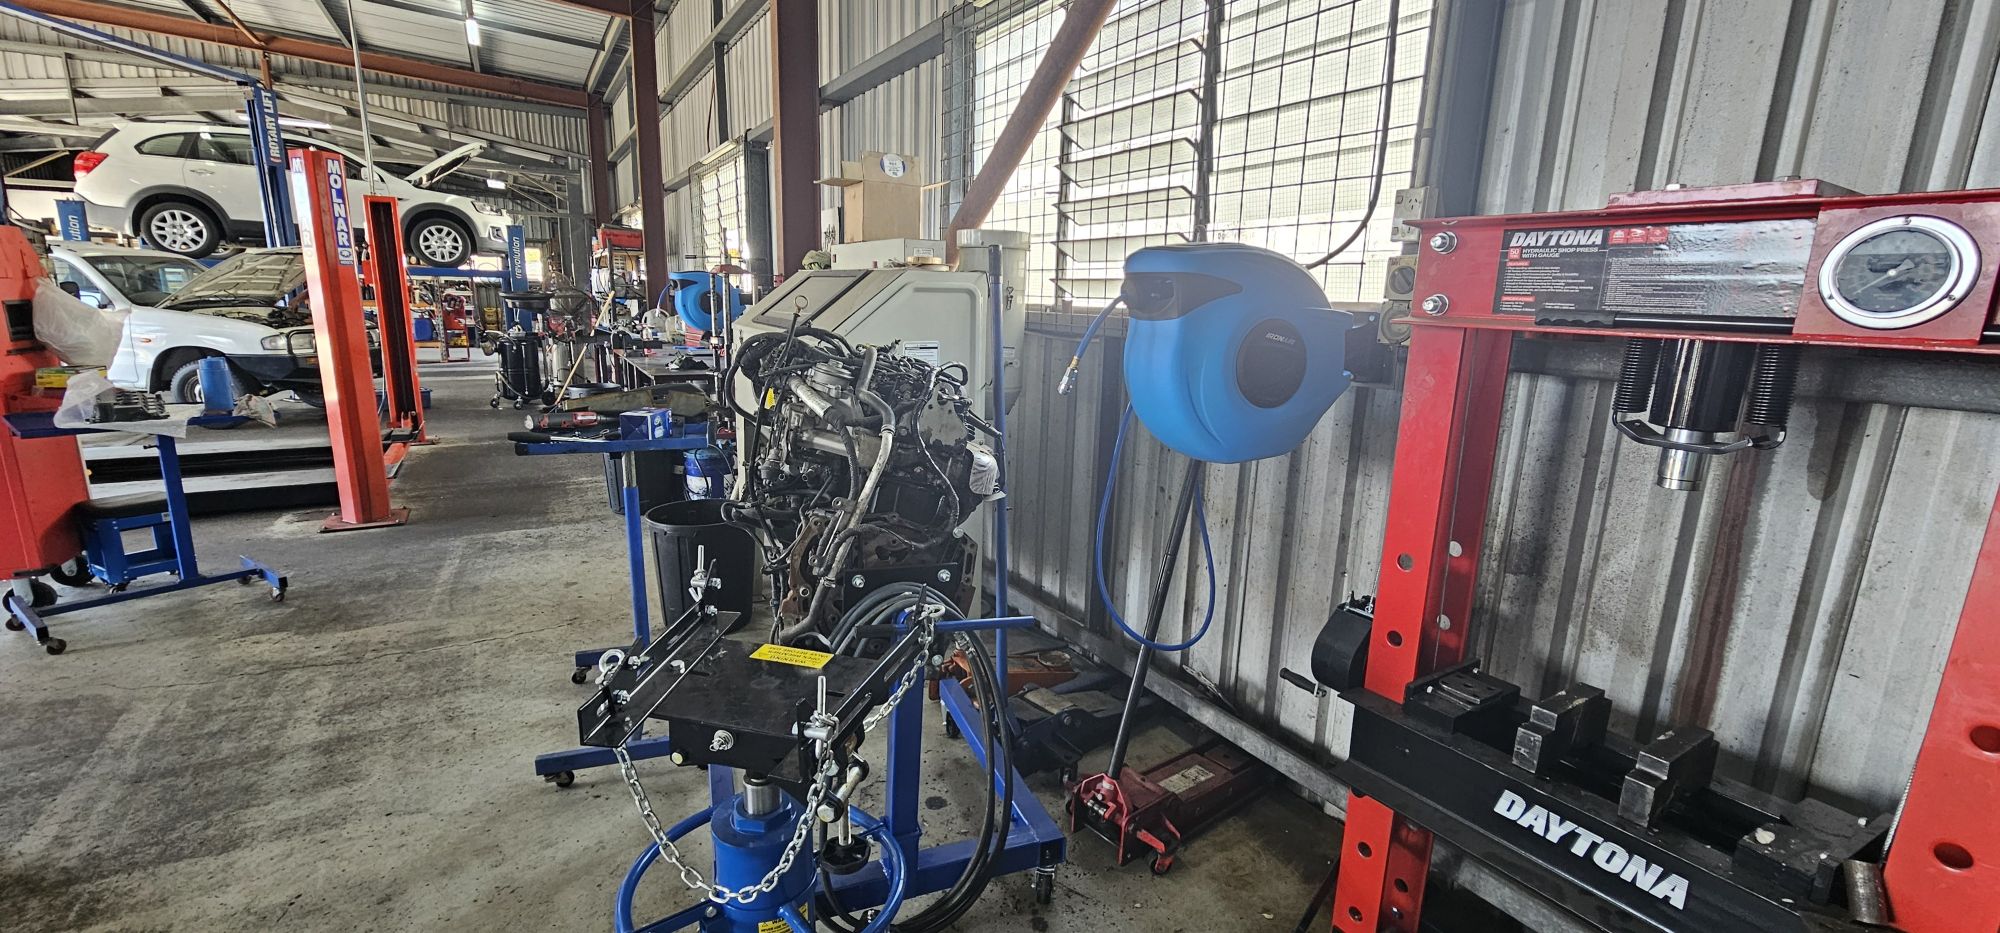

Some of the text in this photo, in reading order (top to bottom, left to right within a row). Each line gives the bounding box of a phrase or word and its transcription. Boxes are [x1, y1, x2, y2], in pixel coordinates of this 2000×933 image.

[261, 91, 280, 157] ROTARY LIFT
[68, 214, 81, 241] ution
[327, 159, 350, 246] MOLNAR
[513, 236, 522, 277] revolution
[1509, 229, 1604, 247] DAYTONA
[1494, 789, 1689, 910] DAYTONA
